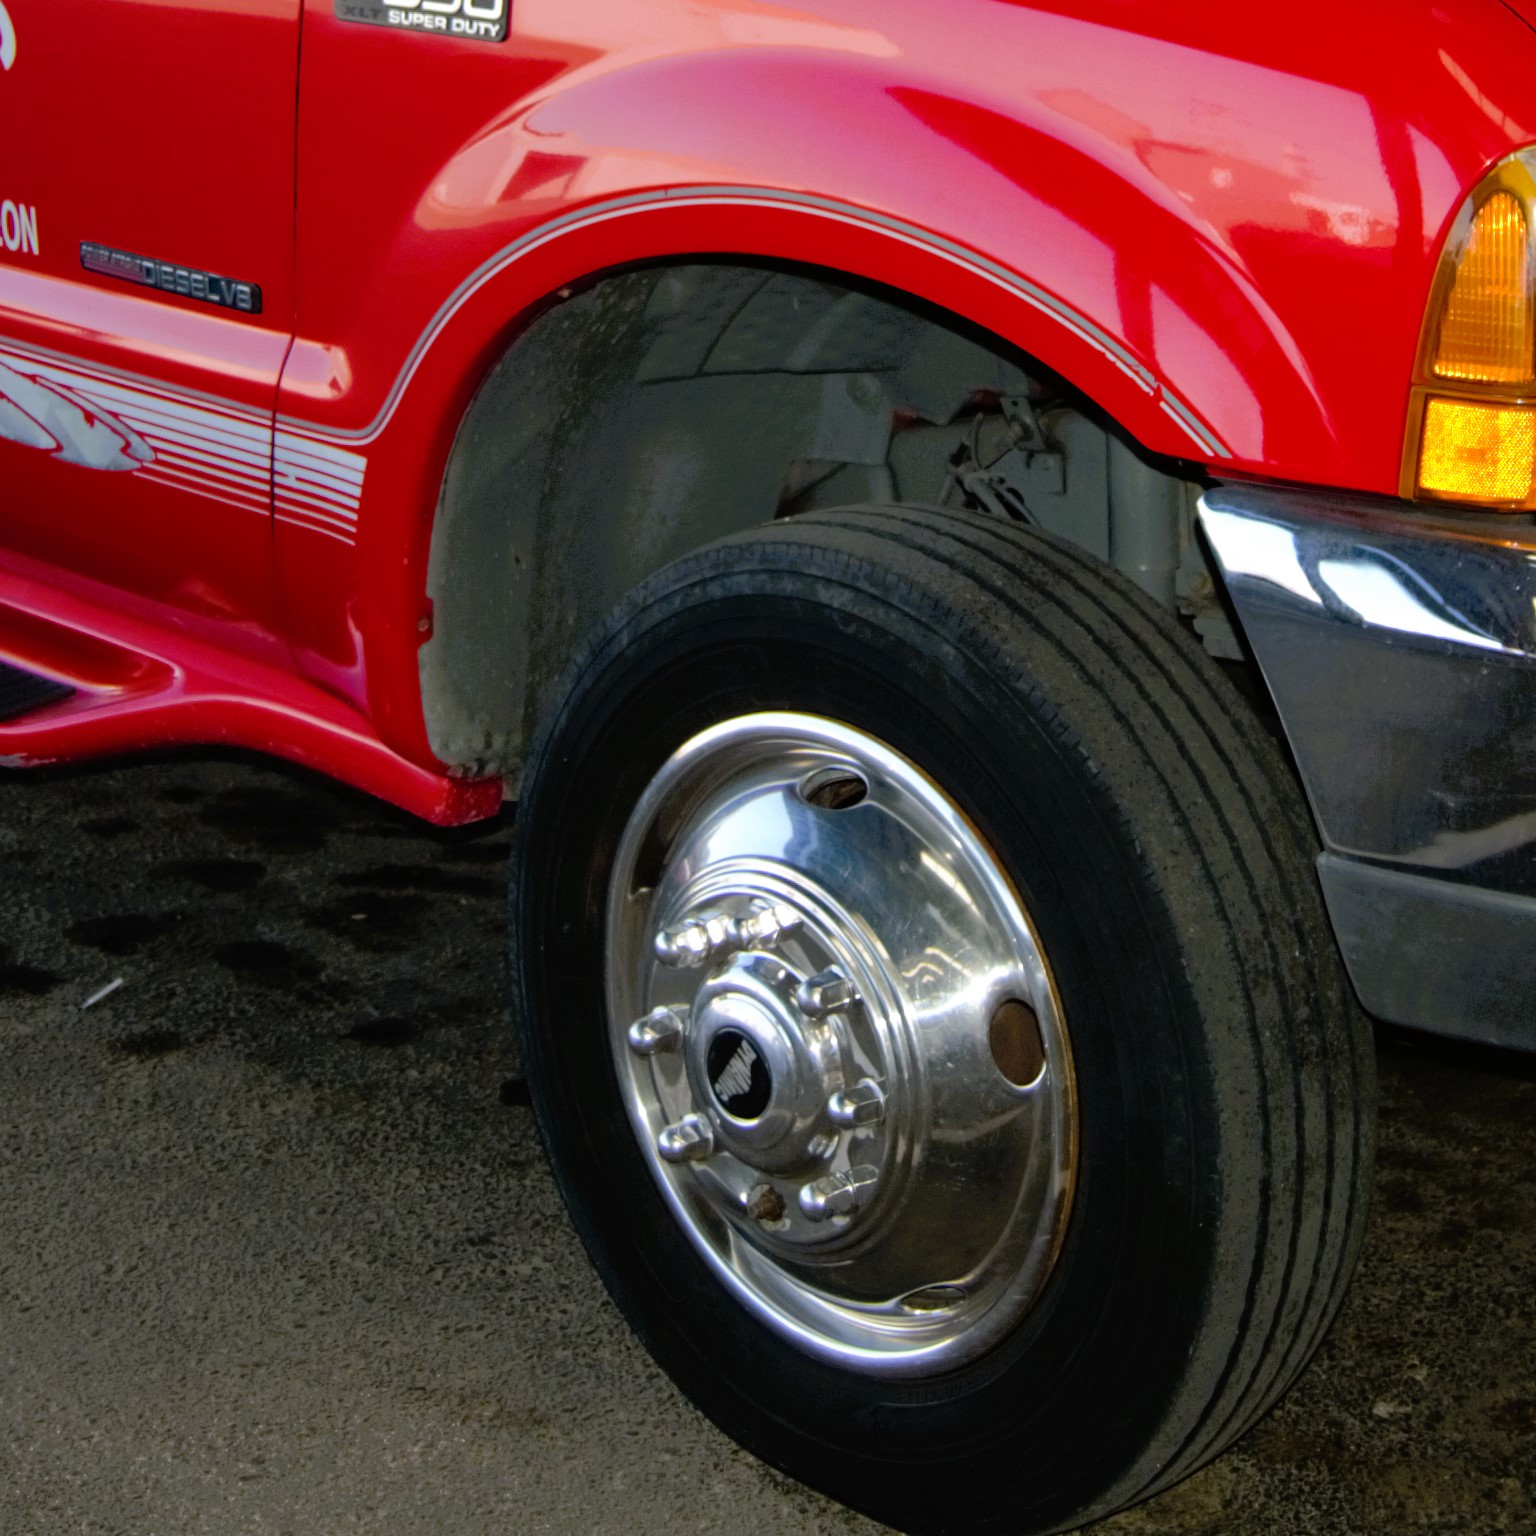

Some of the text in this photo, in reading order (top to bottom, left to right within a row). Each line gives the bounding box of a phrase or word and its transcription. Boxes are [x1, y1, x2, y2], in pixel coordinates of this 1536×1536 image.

[388, 10, 447, 30] SUPER
[452, 17, 500, 38] DUTY
[142, 261, 252, 310] DIESEL V8
